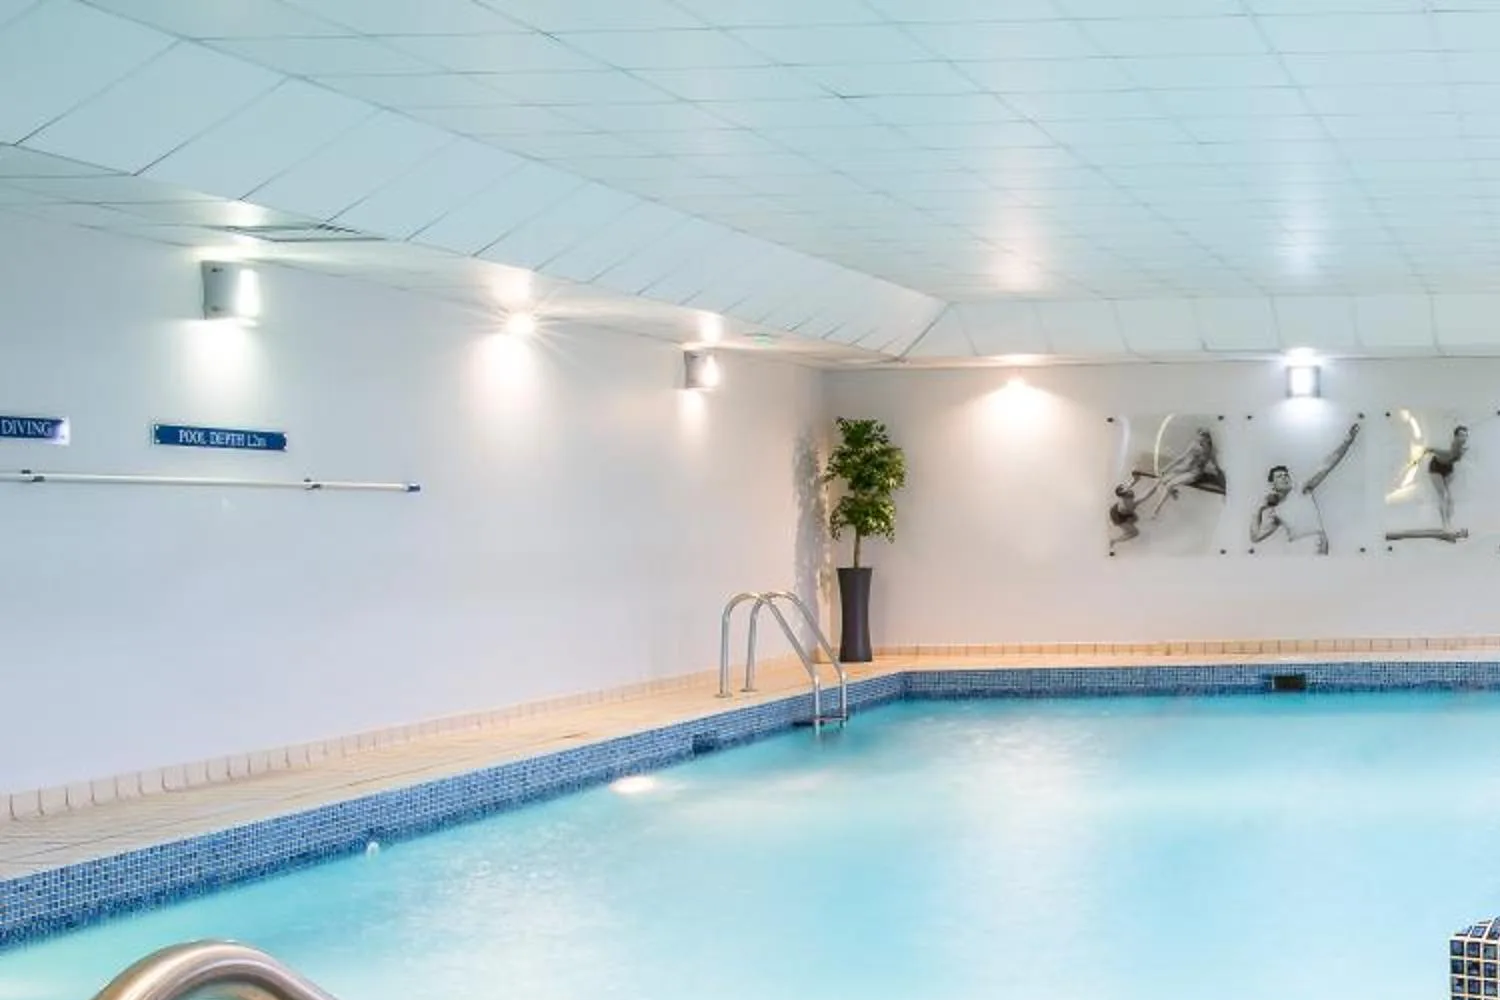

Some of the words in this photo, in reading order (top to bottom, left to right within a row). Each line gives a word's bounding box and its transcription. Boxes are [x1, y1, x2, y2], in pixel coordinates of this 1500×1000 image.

[1, 420, 52, 436] DIVING
[179, 429, 206, 444] POOL
[210, 431, 244, 446] DEPTH
